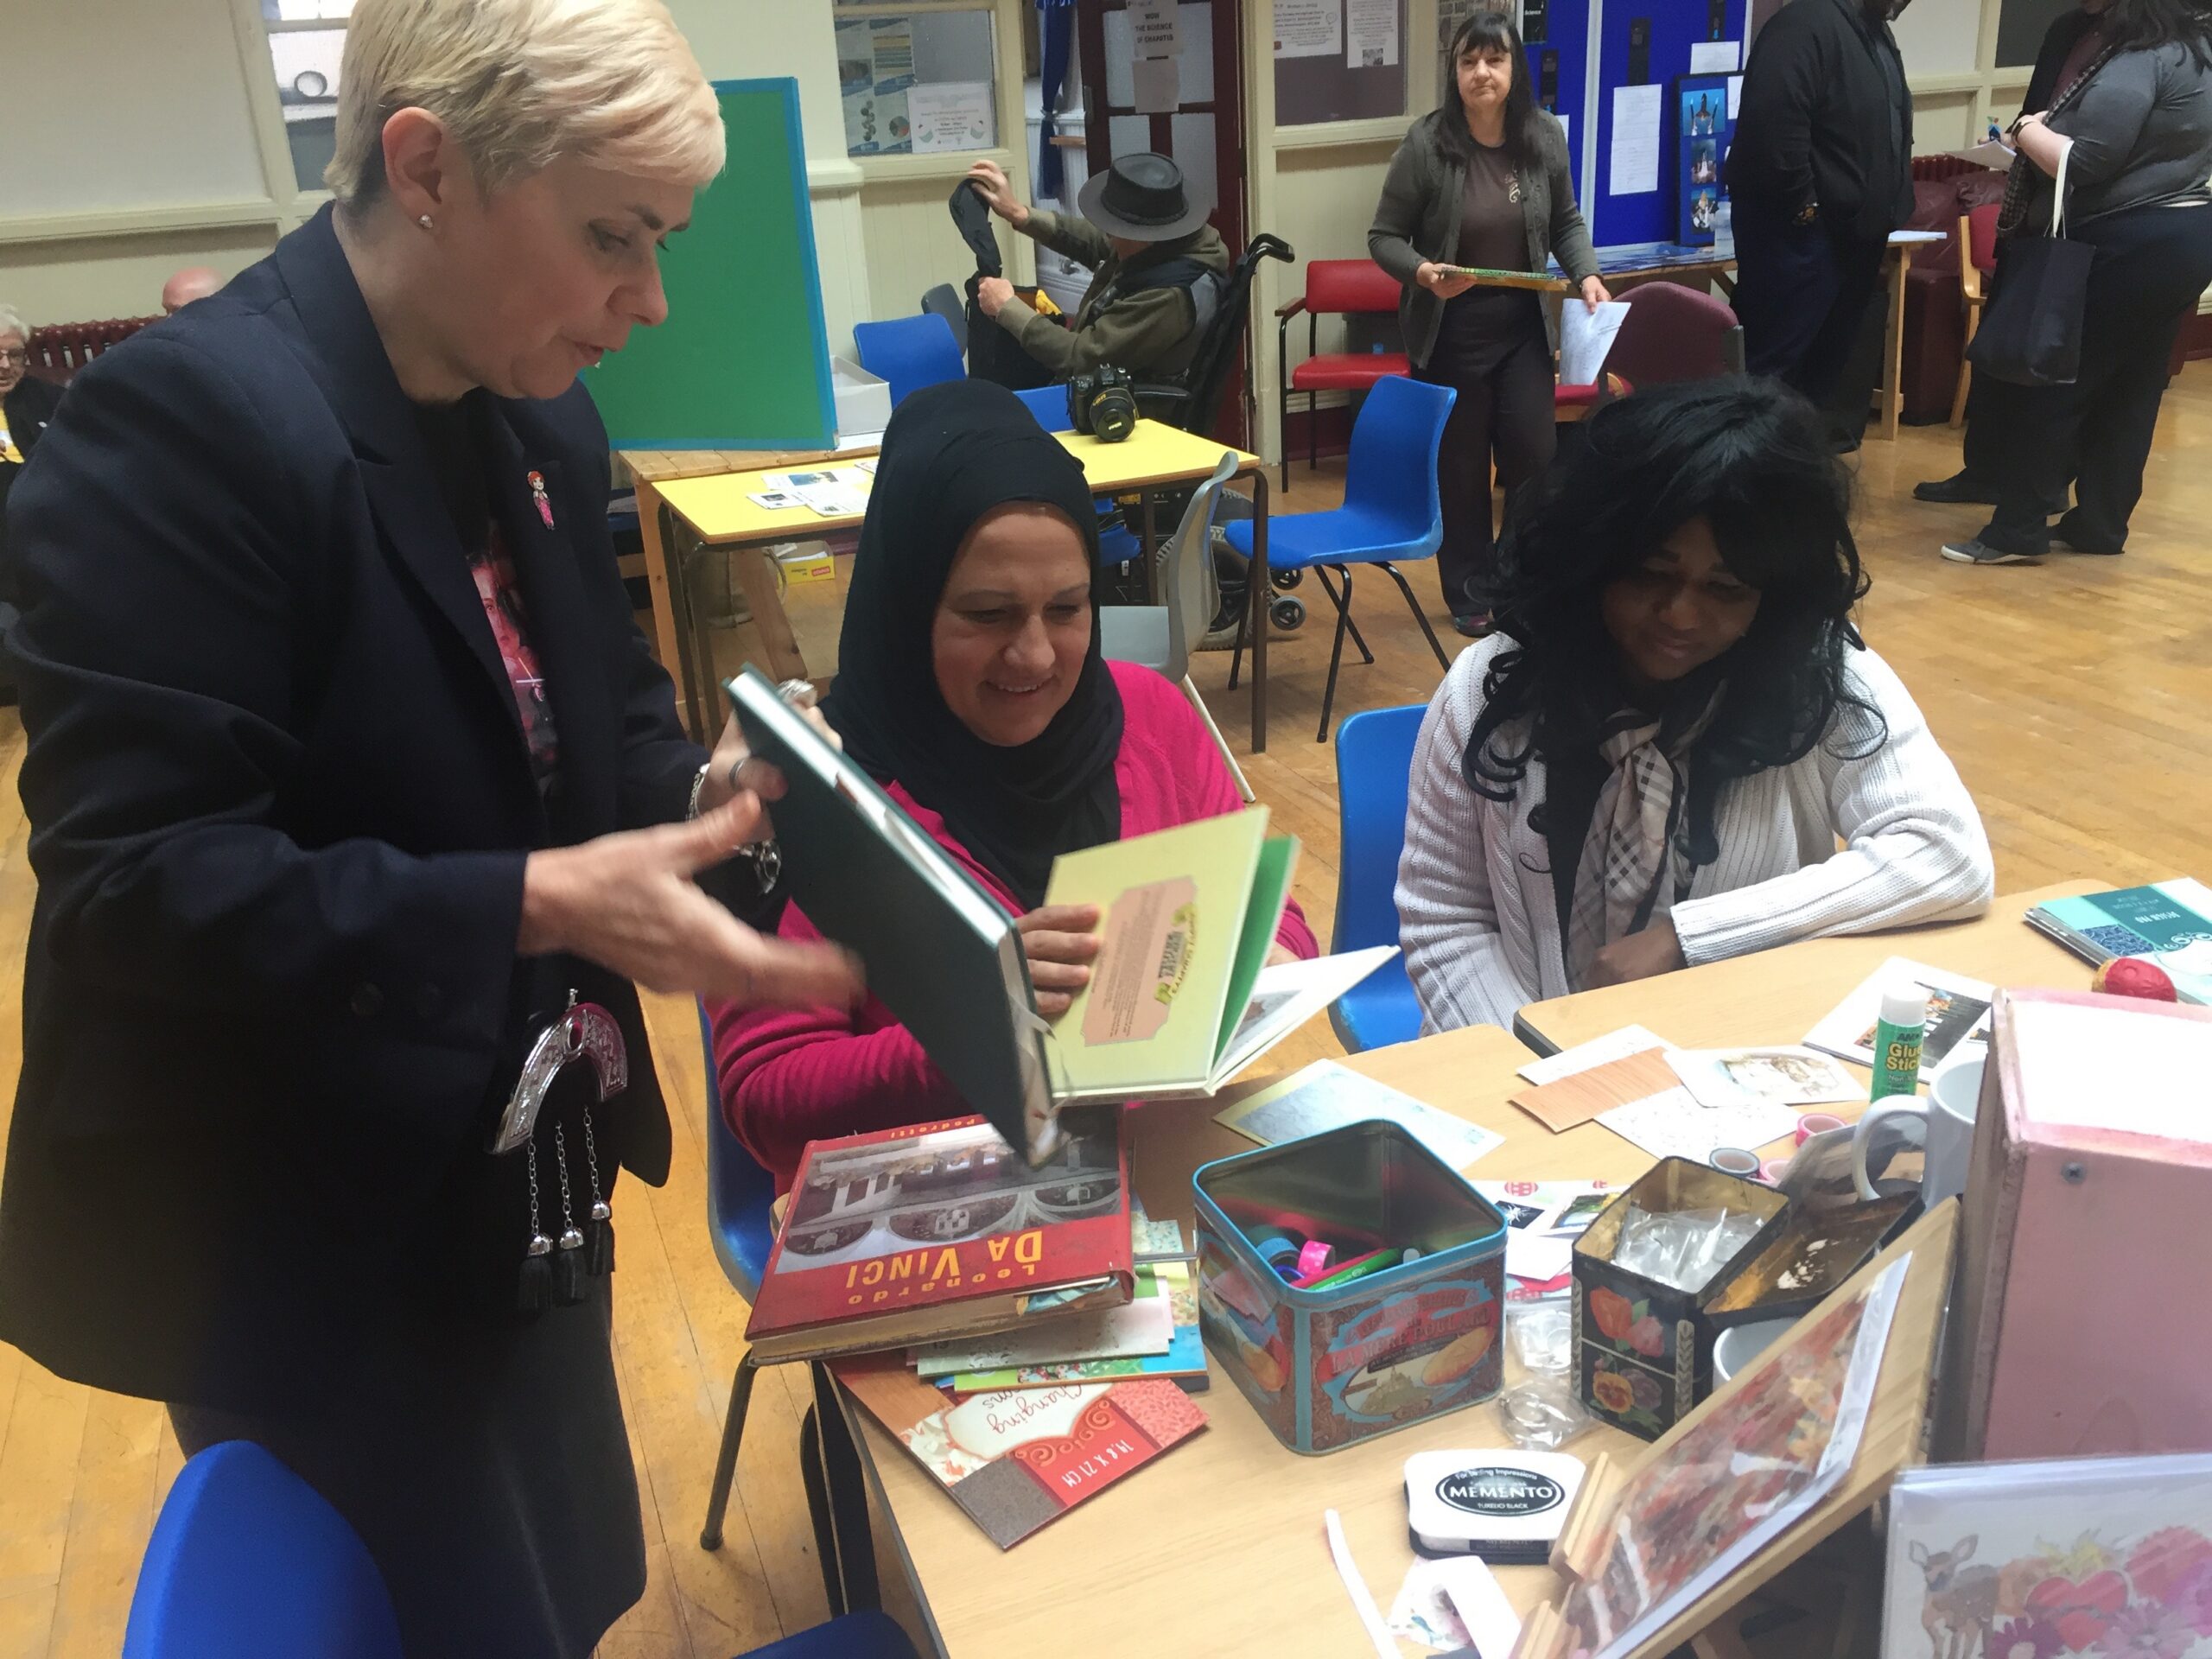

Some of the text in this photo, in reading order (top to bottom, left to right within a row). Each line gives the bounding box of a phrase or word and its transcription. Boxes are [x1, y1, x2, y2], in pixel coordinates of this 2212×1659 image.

[846, 1230, 1043, 1288] DA VINCI
[848, 1264, 1035, 1305] Leonardo
[1061, 1471, 1082, 1488] CM
[1455, 1470, 1467, 1480] For
[1495, 1469, 1538, 1480] Impressions
[1450, 1486, 1553, 1498] MEMENTO
